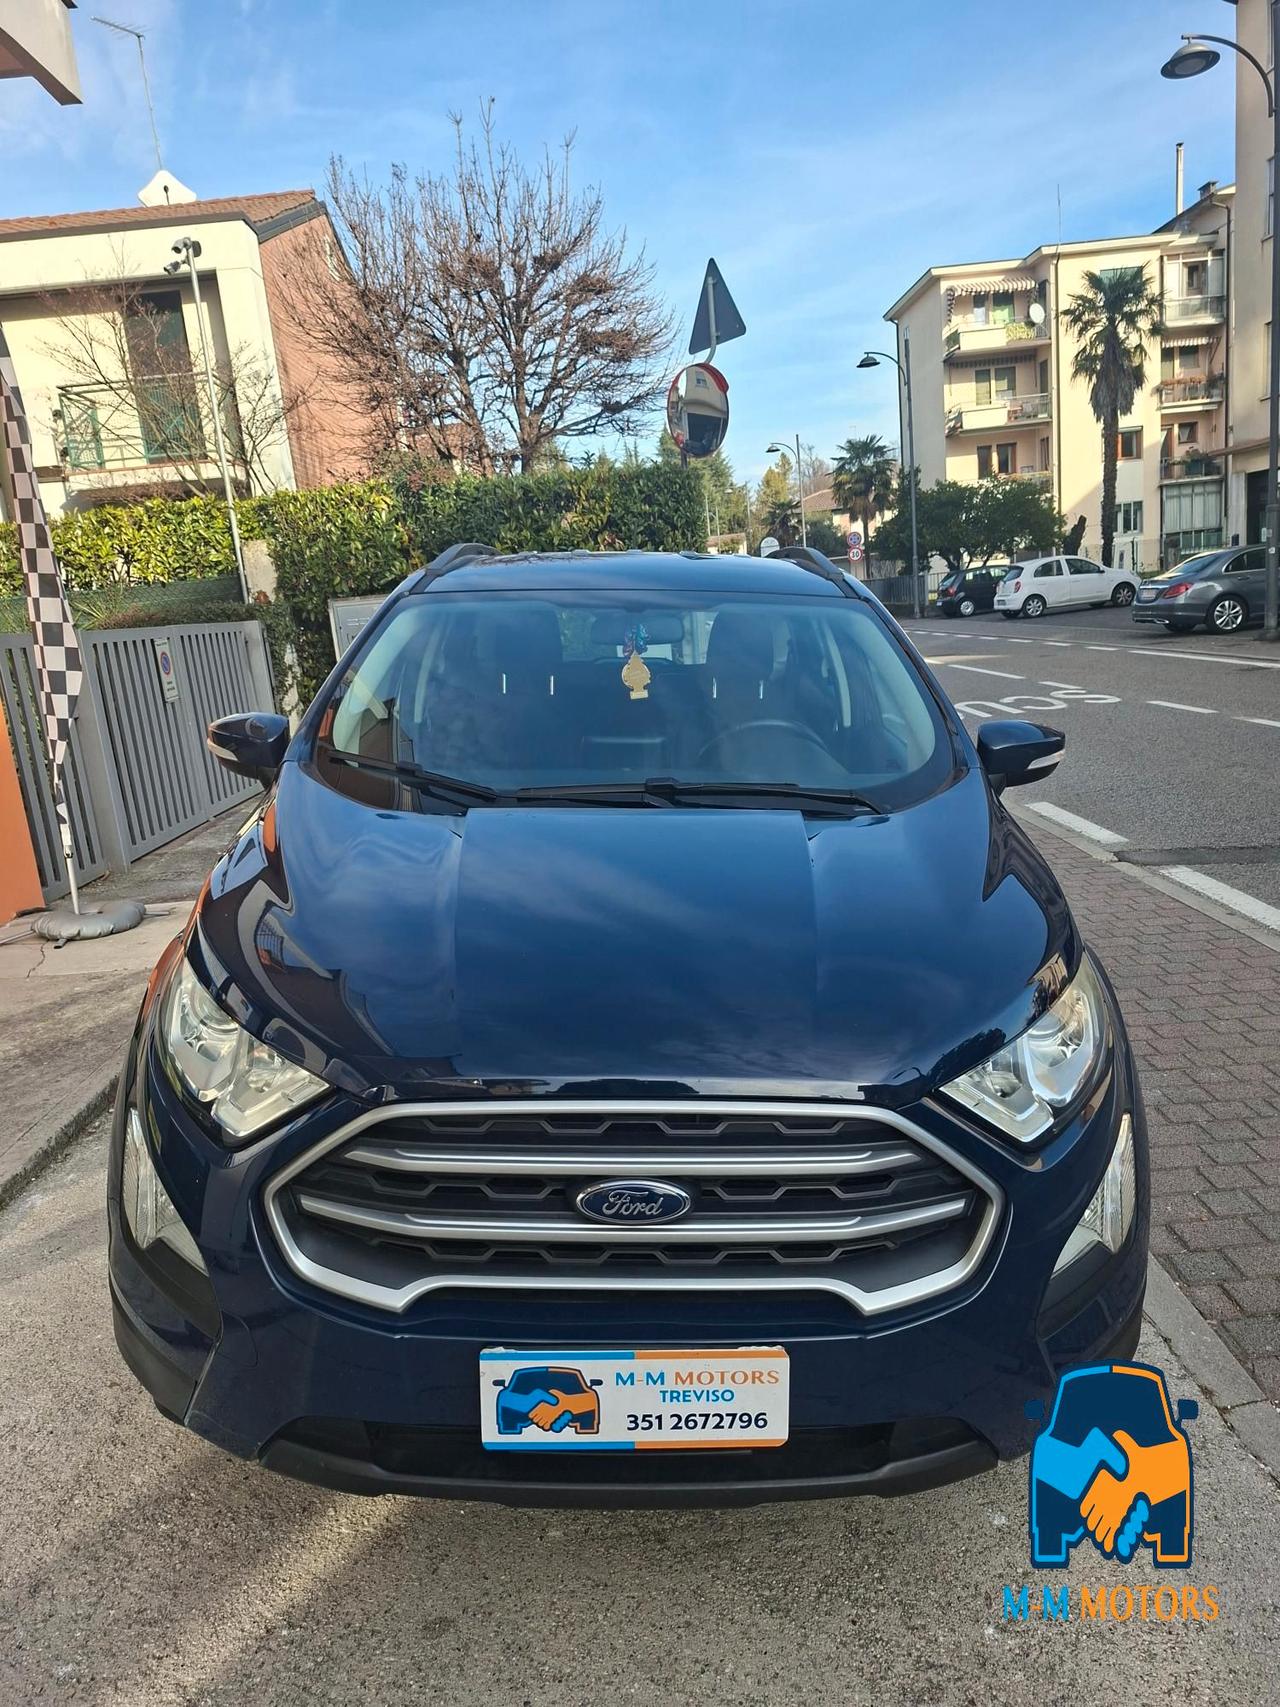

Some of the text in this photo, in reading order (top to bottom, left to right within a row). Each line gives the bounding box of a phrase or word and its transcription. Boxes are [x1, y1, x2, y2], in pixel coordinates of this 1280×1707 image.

[954, 690, 1122, 719] SCU
[602, 1190, 664, 1215] Ford
[616, 1370, 779, 1386] M-M MOTORS
[660, 1389, 734, 1403] TREVISO
